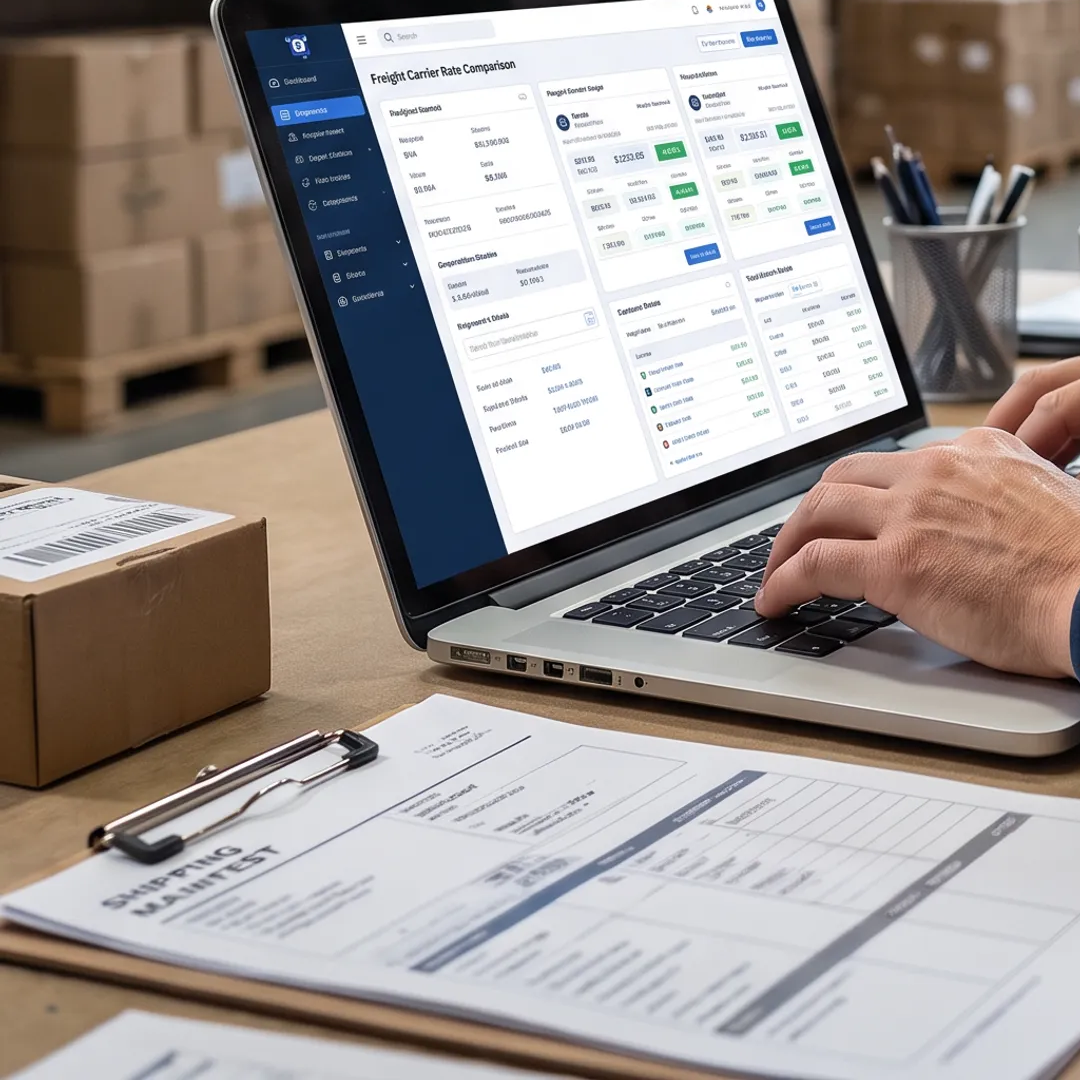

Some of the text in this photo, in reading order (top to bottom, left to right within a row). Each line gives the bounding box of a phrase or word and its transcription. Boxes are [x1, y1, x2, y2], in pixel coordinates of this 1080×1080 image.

[370, 59, 517, 86] Freight Carrier Rate Comparison
[101, 845, 243, 910] SHIPPING
